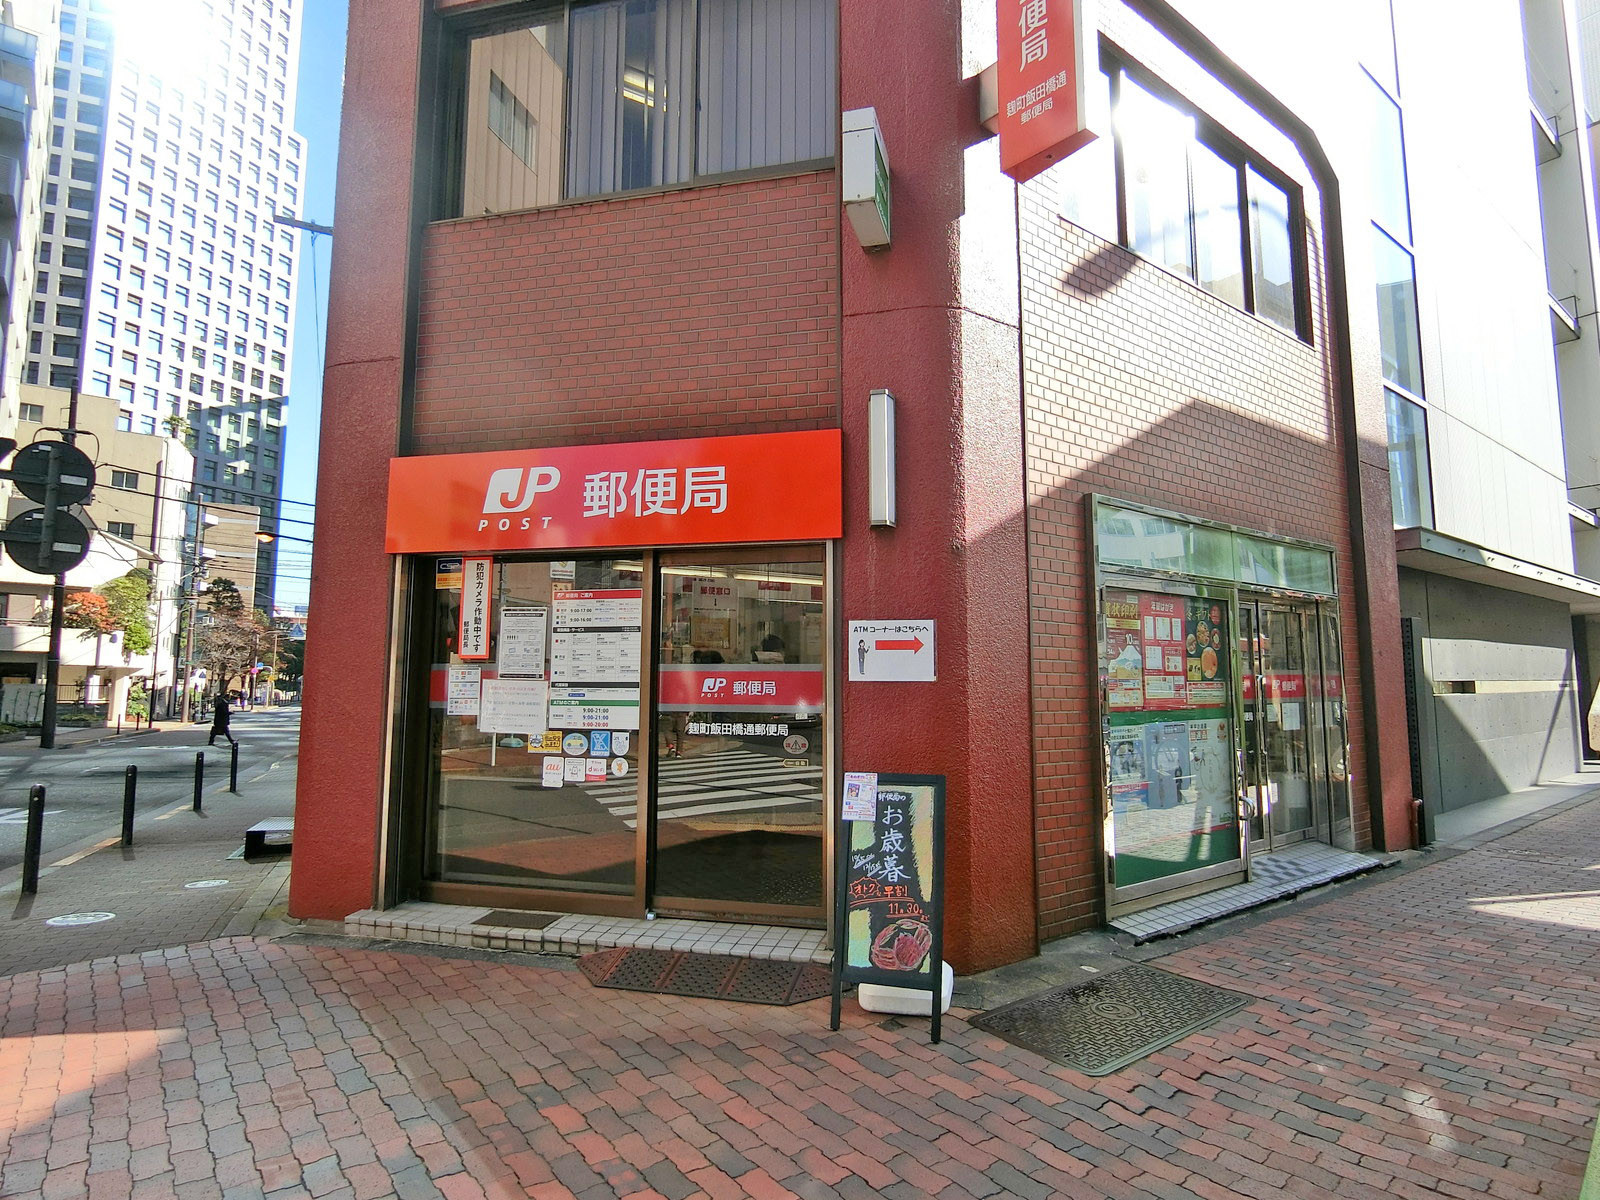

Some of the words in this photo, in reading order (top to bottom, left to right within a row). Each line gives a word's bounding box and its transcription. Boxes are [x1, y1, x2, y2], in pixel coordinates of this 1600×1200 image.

[1018, 0, 1048, 73] 便局
[1020, 97, 1053, 125] 郵便局
[482, 466, 561, 514] JP
[583, 466, 728, 518] 郵便局
[478, 516, 552, 532] POST
[473, 562, 485, 653] 防犯カメラ作動中です
[853, 625, 929, 633] ATMコーナーはこちらへ
[701, 677, 727, 693] JP
[733, 680, 776, 696] 郵便局
[688, 722, 789, 737] 麹町飯田橋通郵便局
[545, 763, 562, 771] au
[878, 792, 907, 802] 郵便局の
[877, 805, 911, 883] お歳暮
